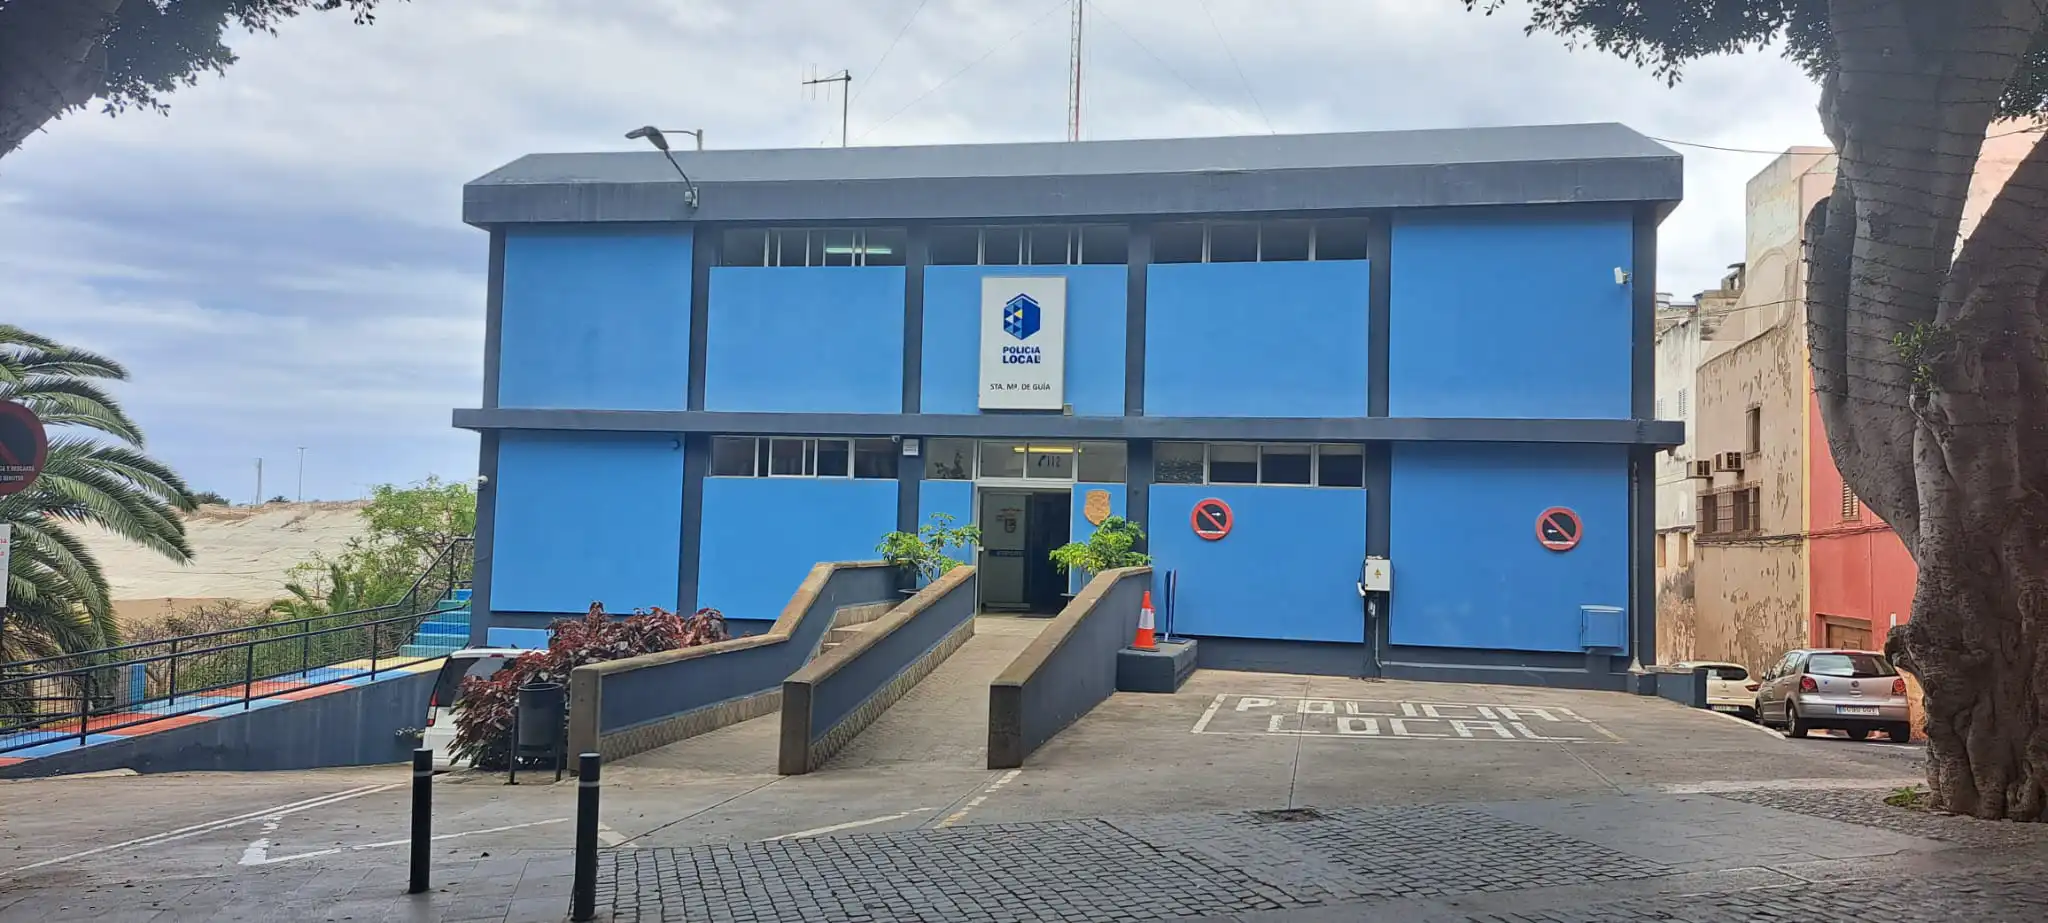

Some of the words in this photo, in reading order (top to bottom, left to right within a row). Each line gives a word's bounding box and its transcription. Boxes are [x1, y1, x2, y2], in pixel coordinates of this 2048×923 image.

[1002, 355, 1041, 364] LOCAL
[1021, 383, 1030, 391] DE
[1032, 381, 1051, 391] GUÍA
[1235, 697, 1562, 722] POLICIA
[1266, 713, 1586, 740] LOCAL
